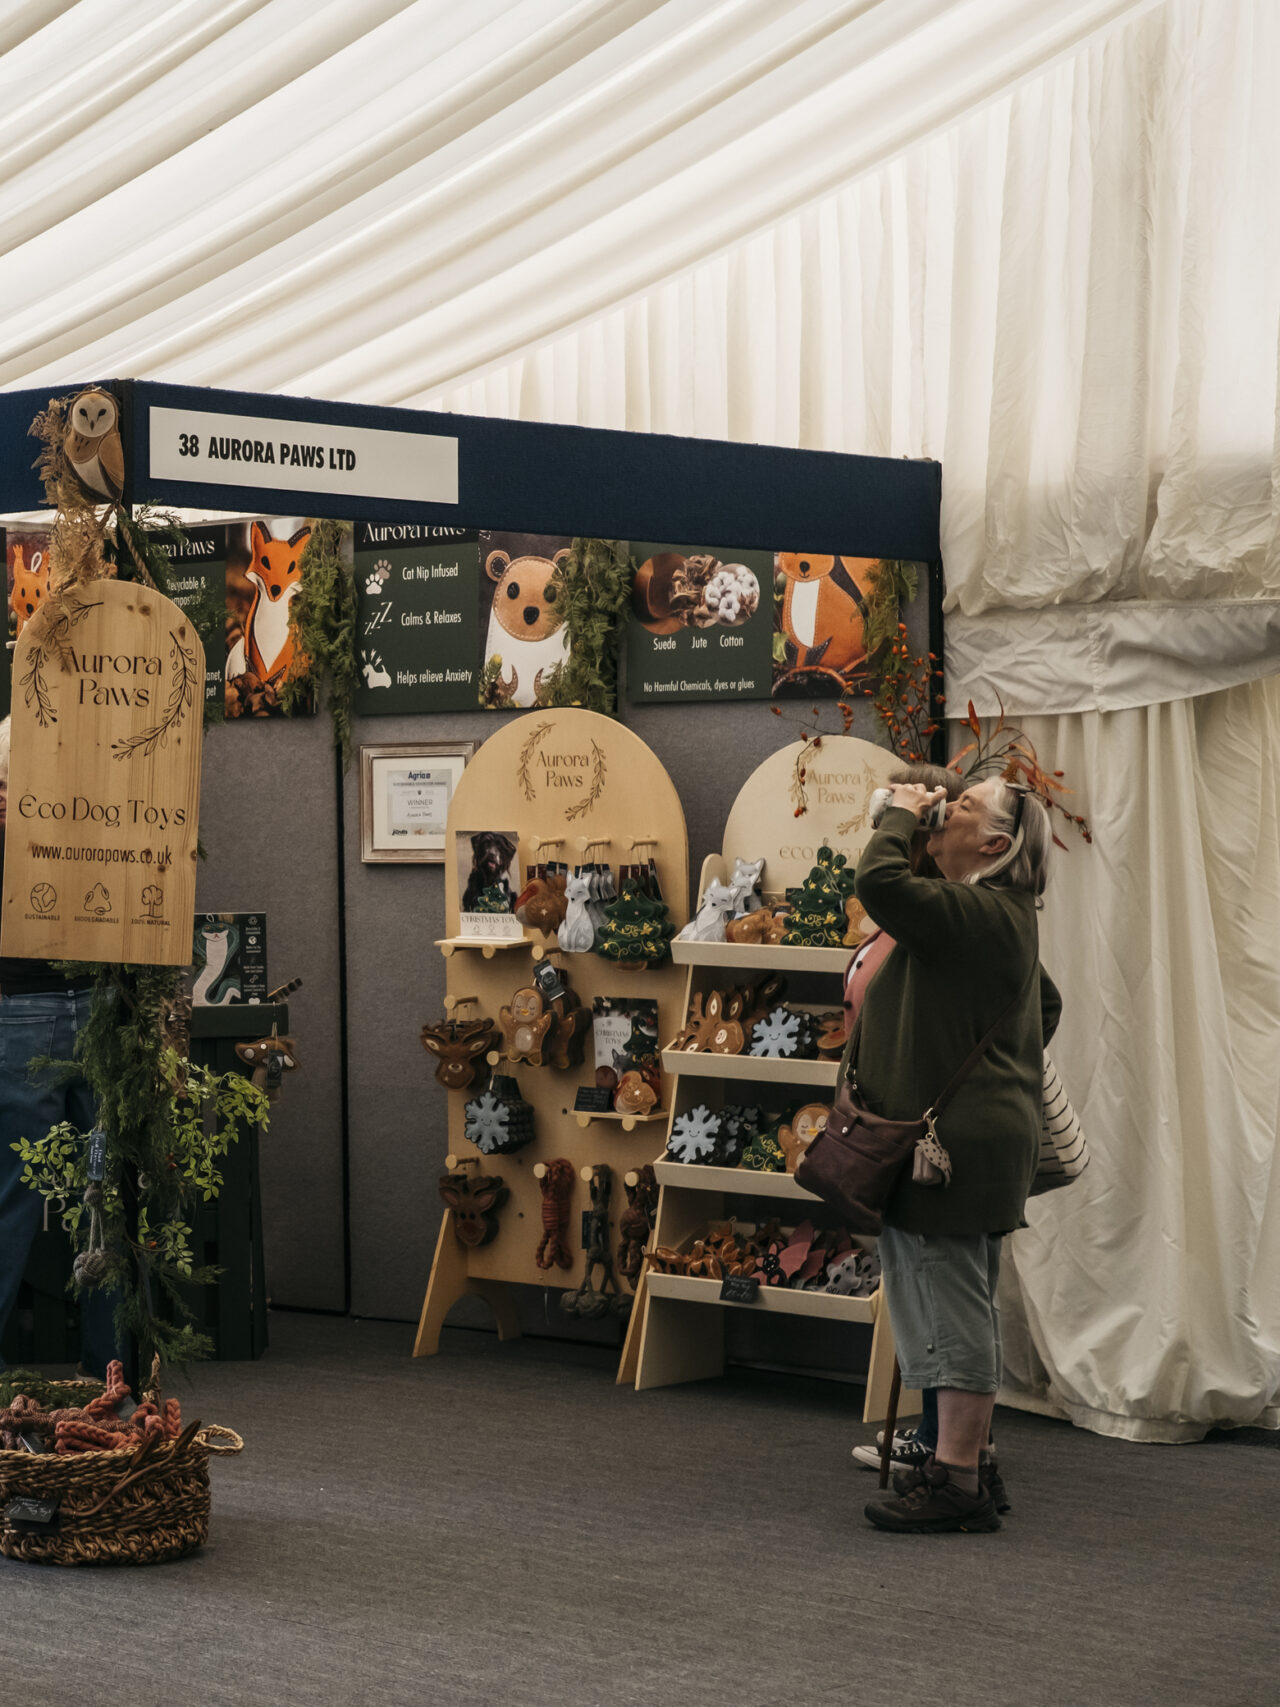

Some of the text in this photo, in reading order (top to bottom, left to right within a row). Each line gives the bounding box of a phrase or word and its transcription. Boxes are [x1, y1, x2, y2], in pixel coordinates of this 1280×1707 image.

[178, 433, 356, 471] 38 AURORA PAWS LTD
[363, 523, 420, 543] Aurora
[402, 562, 459, 581] Cat Nip Infused
[401, 610, 462, 626] Calms & Relaxes
[653, 634, 744, 650] Suede Jute Cotton
[61, 647, 162, 676] Aurora
[397, 669, 472, 686] Helps relieve Anxiety
[643, 677, 755, 693] No Harmful Chemicals, dyes or glues
[79, 678, 150, 708] Paws
[205, 685, 217, 699] pet
[536, 750, 590, 768] Aurora
[545, 770, 584, 788] Paws
[807, 769, 861, 785] Aurora
[818, 786, 856, 804] Paws
[18, 795, 186, 831] Eco Dog Toys
[31, 845, 173, 867] www.aurorapaws.co.uk
